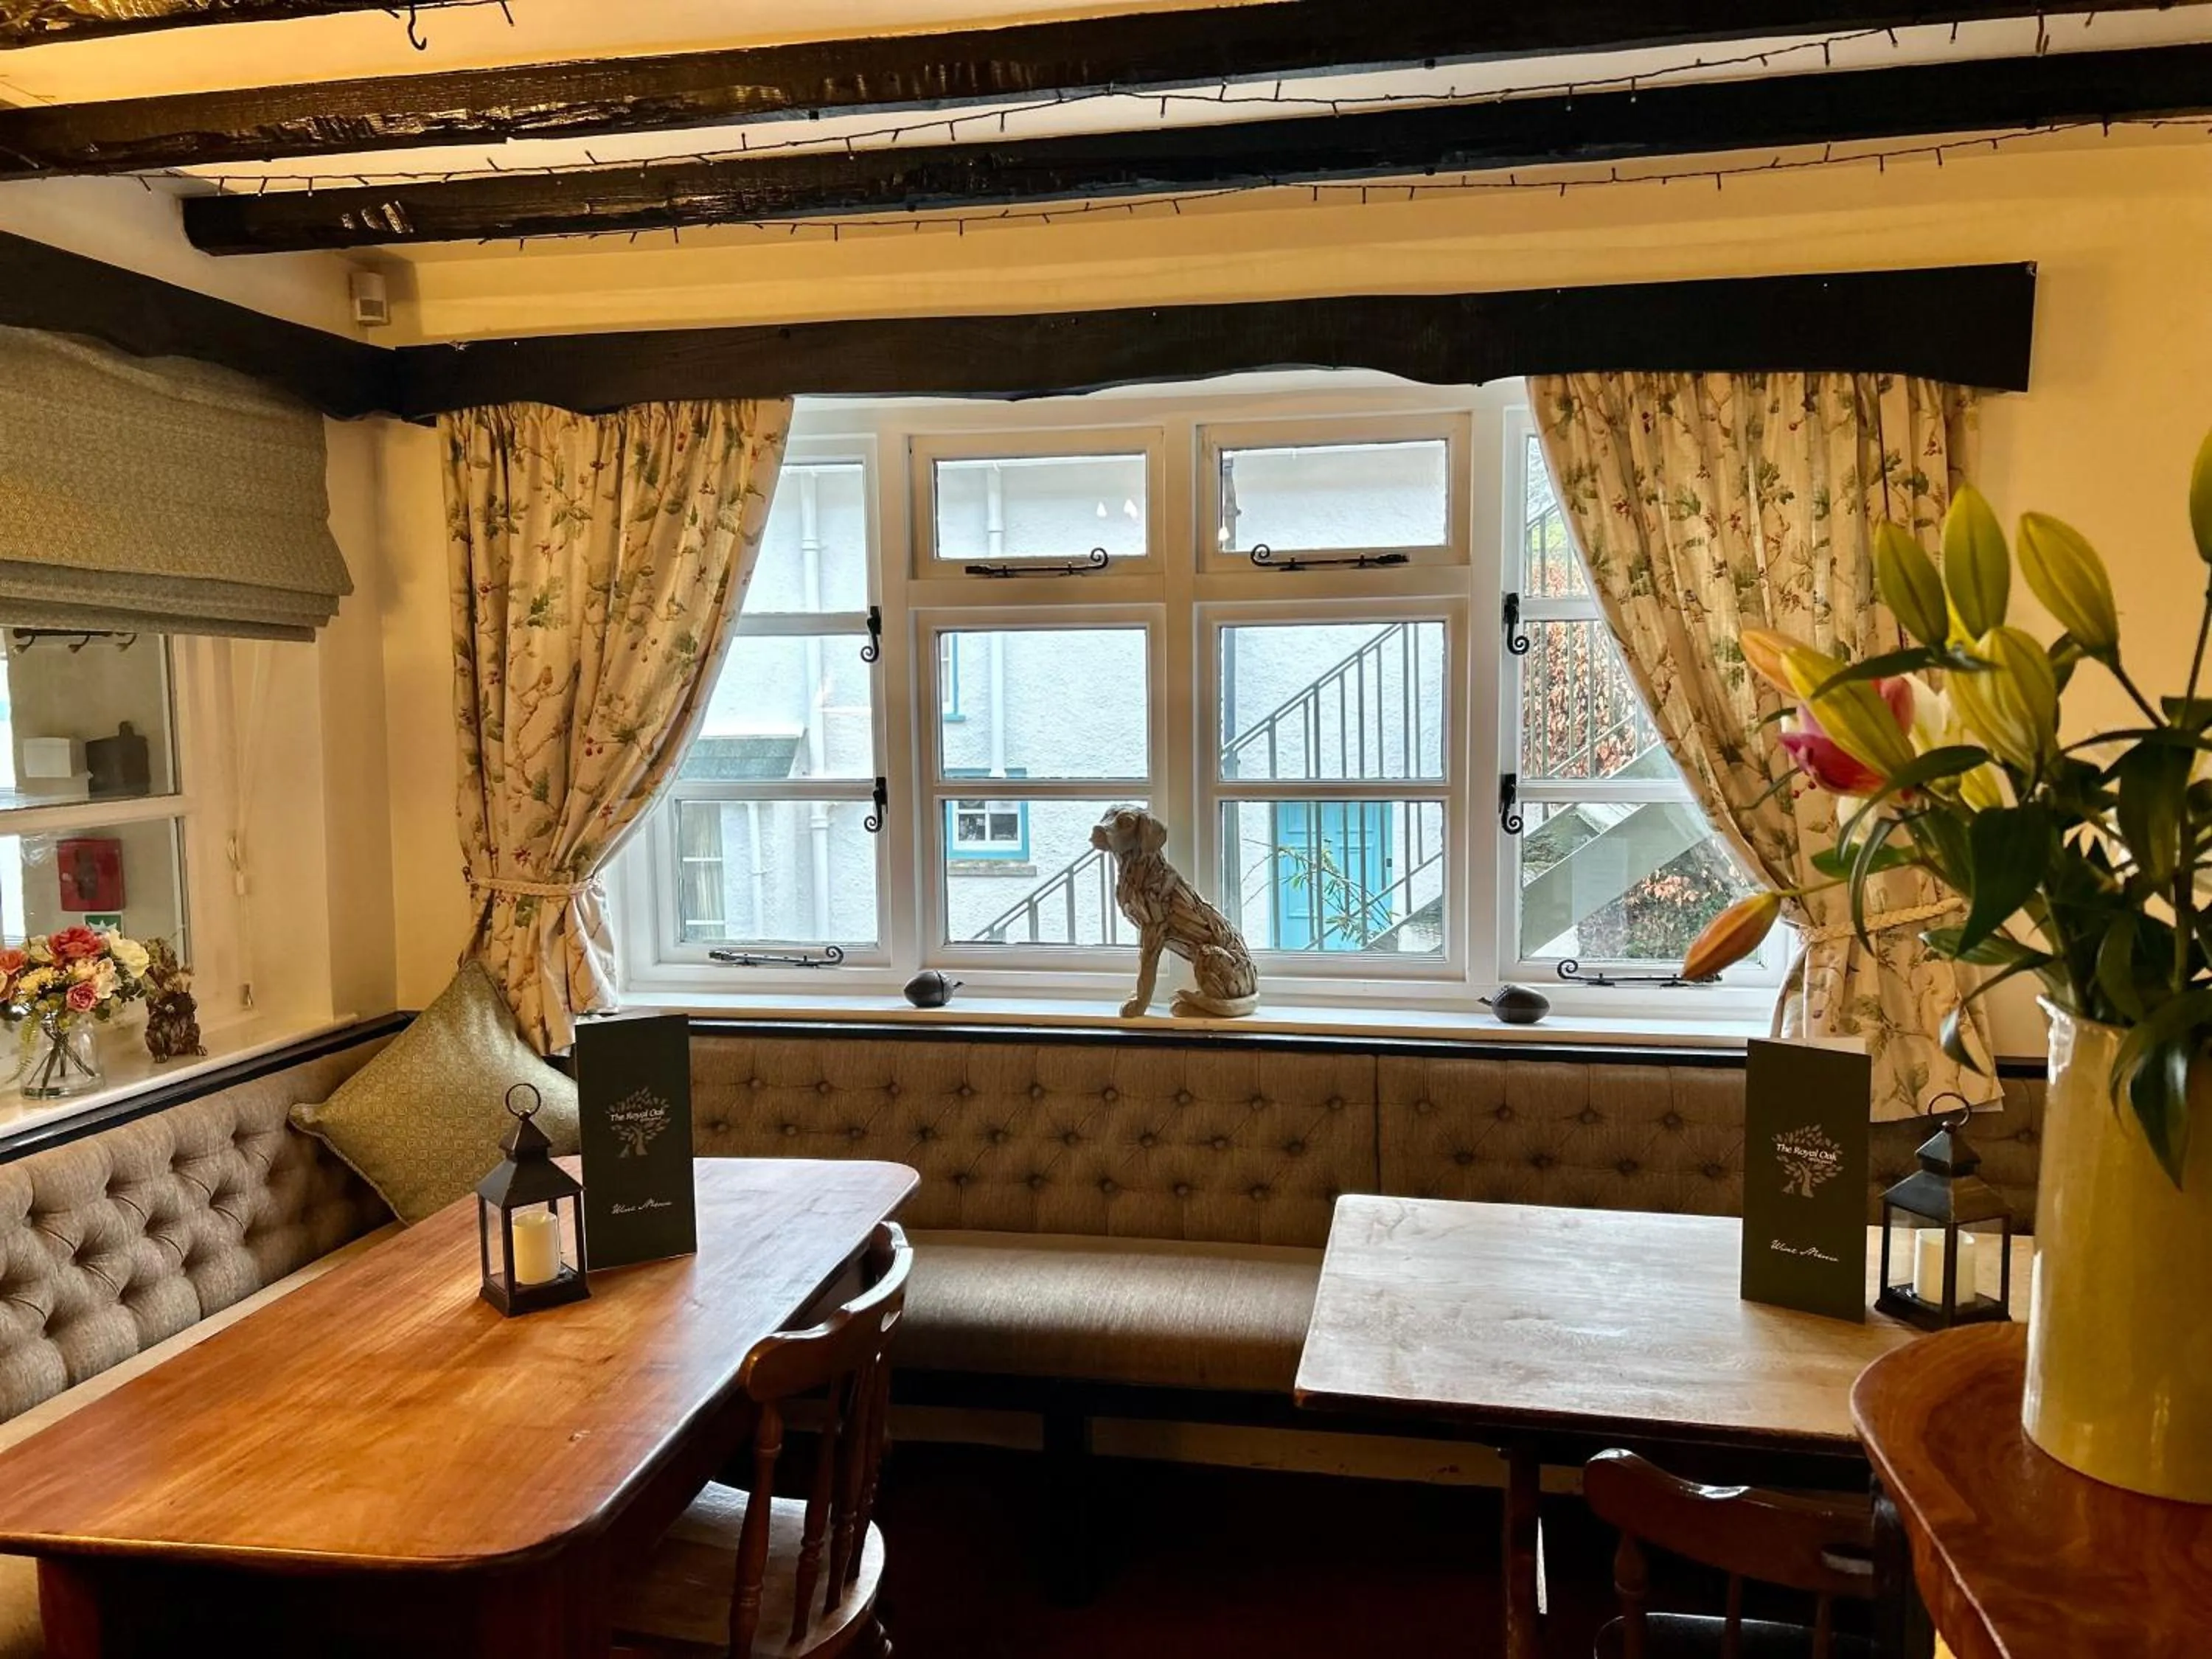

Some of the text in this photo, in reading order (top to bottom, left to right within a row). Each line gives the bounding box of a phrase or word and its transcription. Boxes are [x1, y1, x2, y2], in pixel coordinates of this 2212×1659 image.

[611, 1113, 625, 1121] The
[626, 1109, 648, 1121] Royal
[650, 1107, 664, 1117] Oak
[1776, 1144, 1792, 1153] The
[1793, 1147, 1818, 1158] Royal
[1819, 1150, 1837, 1161] Oak
[1771, 1239, 1839, 1262] Wine Menu
